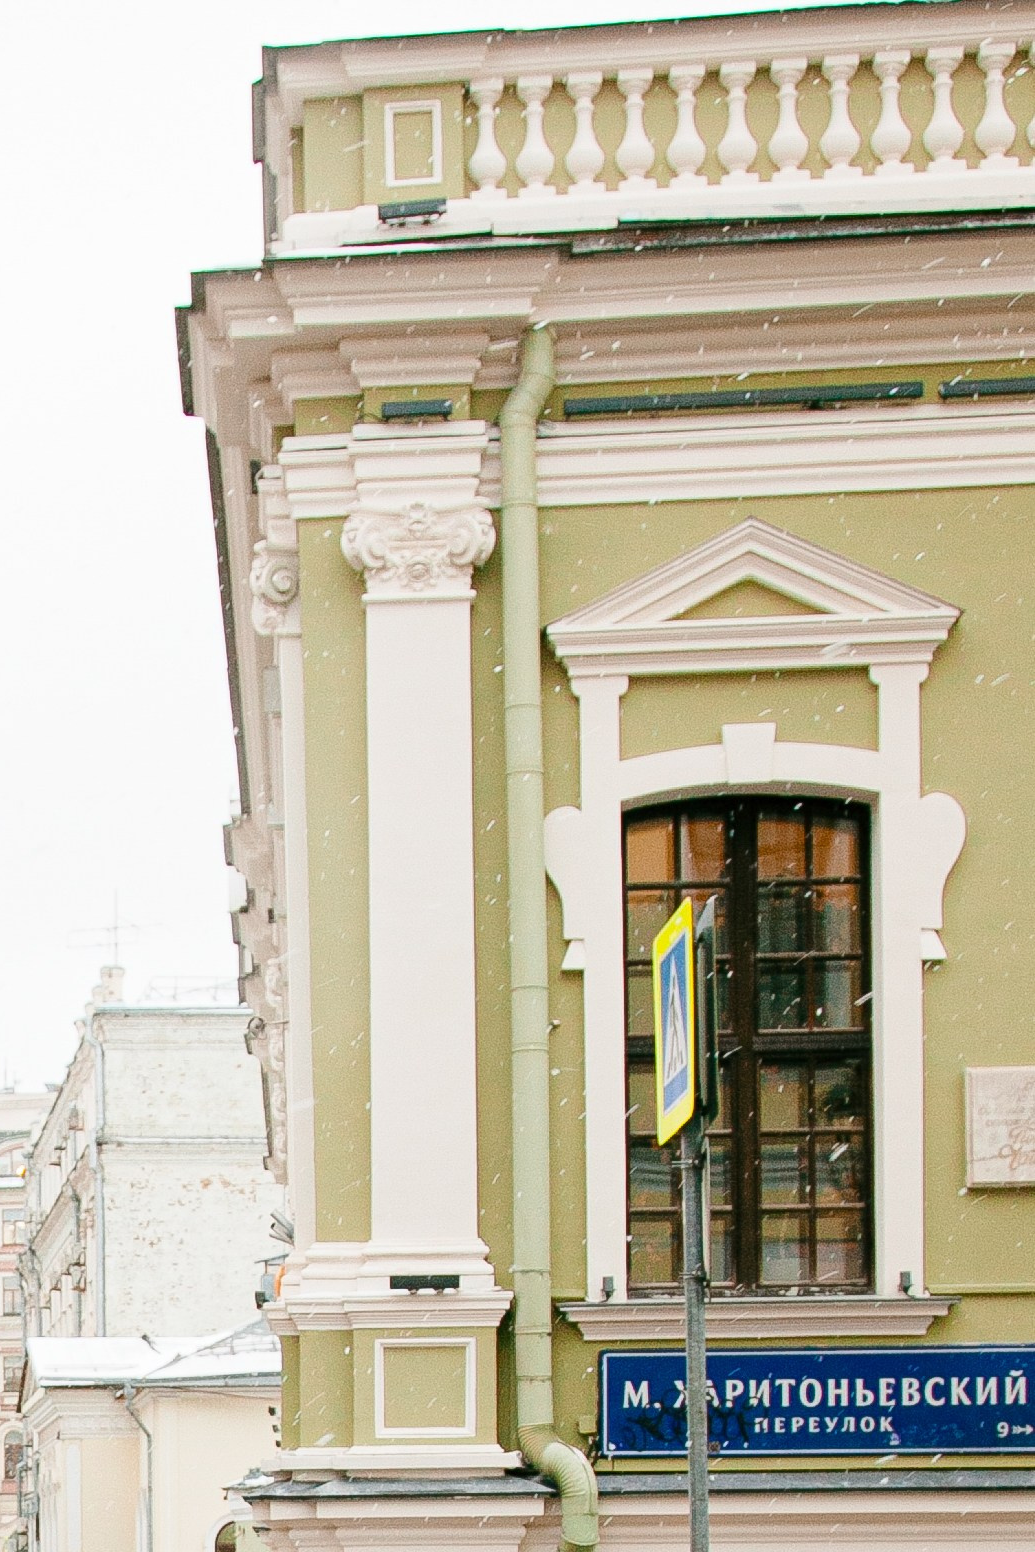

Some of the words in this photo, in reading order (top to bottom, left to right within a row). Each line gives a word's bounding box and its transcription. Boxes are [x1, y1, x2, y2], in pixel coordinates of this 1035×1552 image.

[623, 1380, 662, 1409] М.
[754, 1416, 894, 1434] ПЕРЕУЛОК
[997, 1421, 1010, 1438] 9
